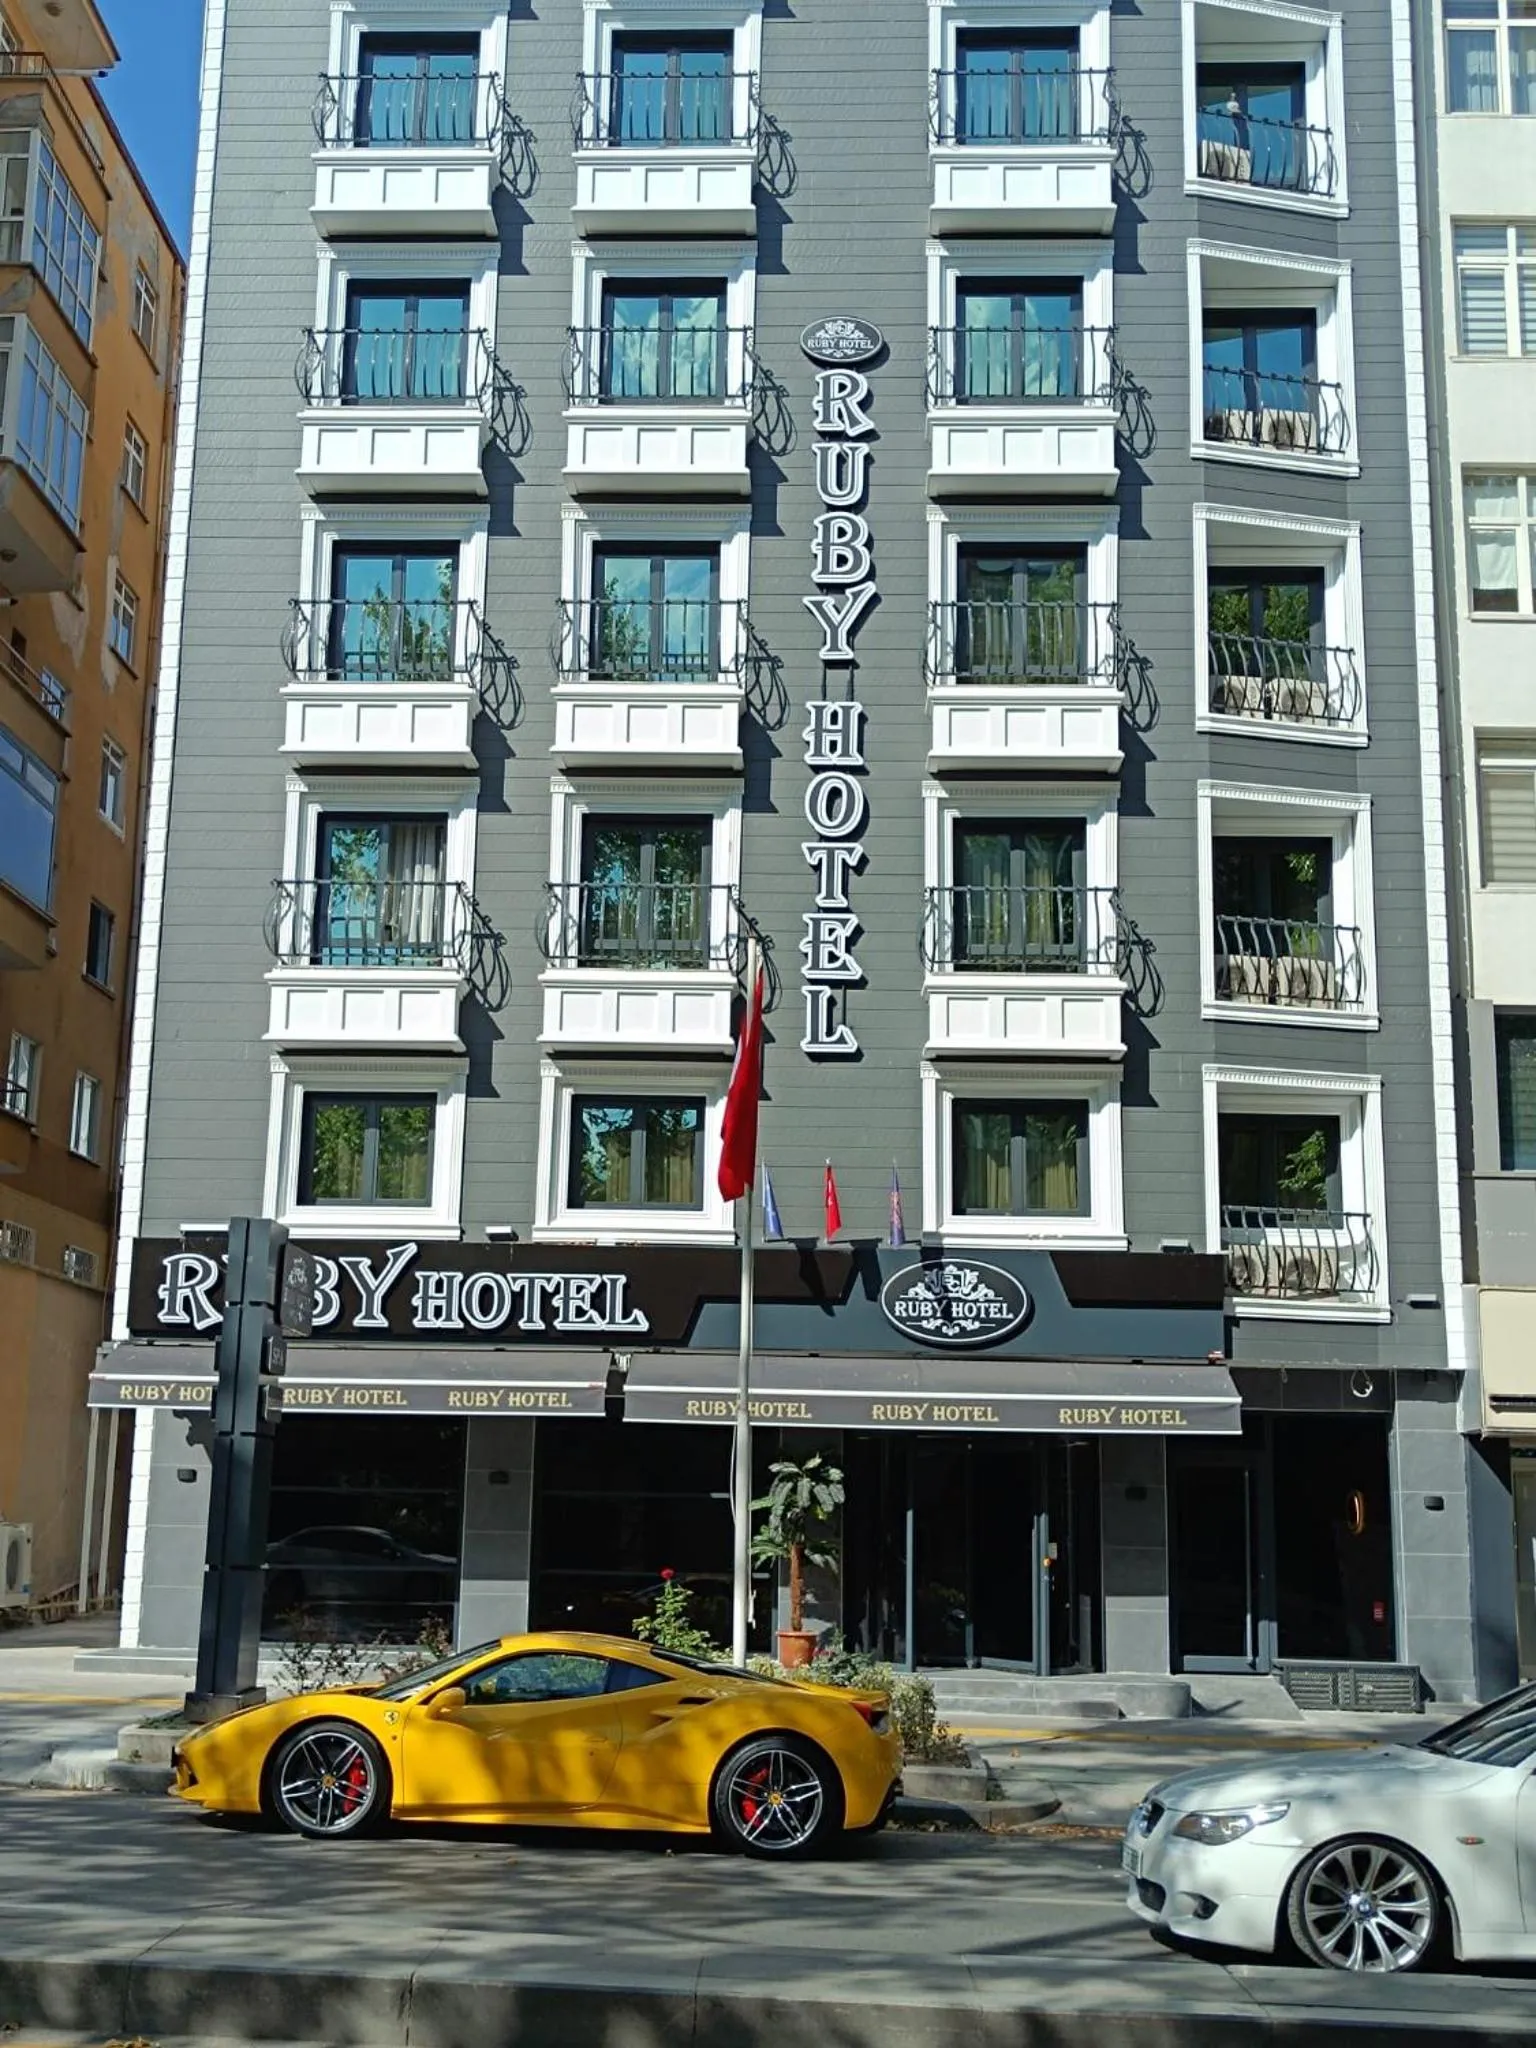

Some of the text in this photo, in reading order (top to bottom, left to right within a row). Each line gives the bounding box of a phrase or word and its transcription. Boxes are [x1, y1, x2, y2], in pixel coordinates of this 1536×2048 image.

[807, 338, 874, 349] RUBY HOTEL
[800, 368, 876, 1053] RUBY HOTEL
[156, 1241, 418, 1331] RBY
[411, 1271, 650, 1332] HOTEL
[894, 1300, 1014, 1319] RUBY HOTEL
[119, 1383, 176, 1401] RUBY
[283, 1386, 408, 1406] RUBY HOTEL
[448, 1388, 572, 1408] RUBY HOTEL
[686, 1400, 812, 1419] RUBY HOTEL
[872, 1403, 999, 1422] RUBY HOTEL
[1058, 1406, 1188, 1425] RUBY HOTEL
